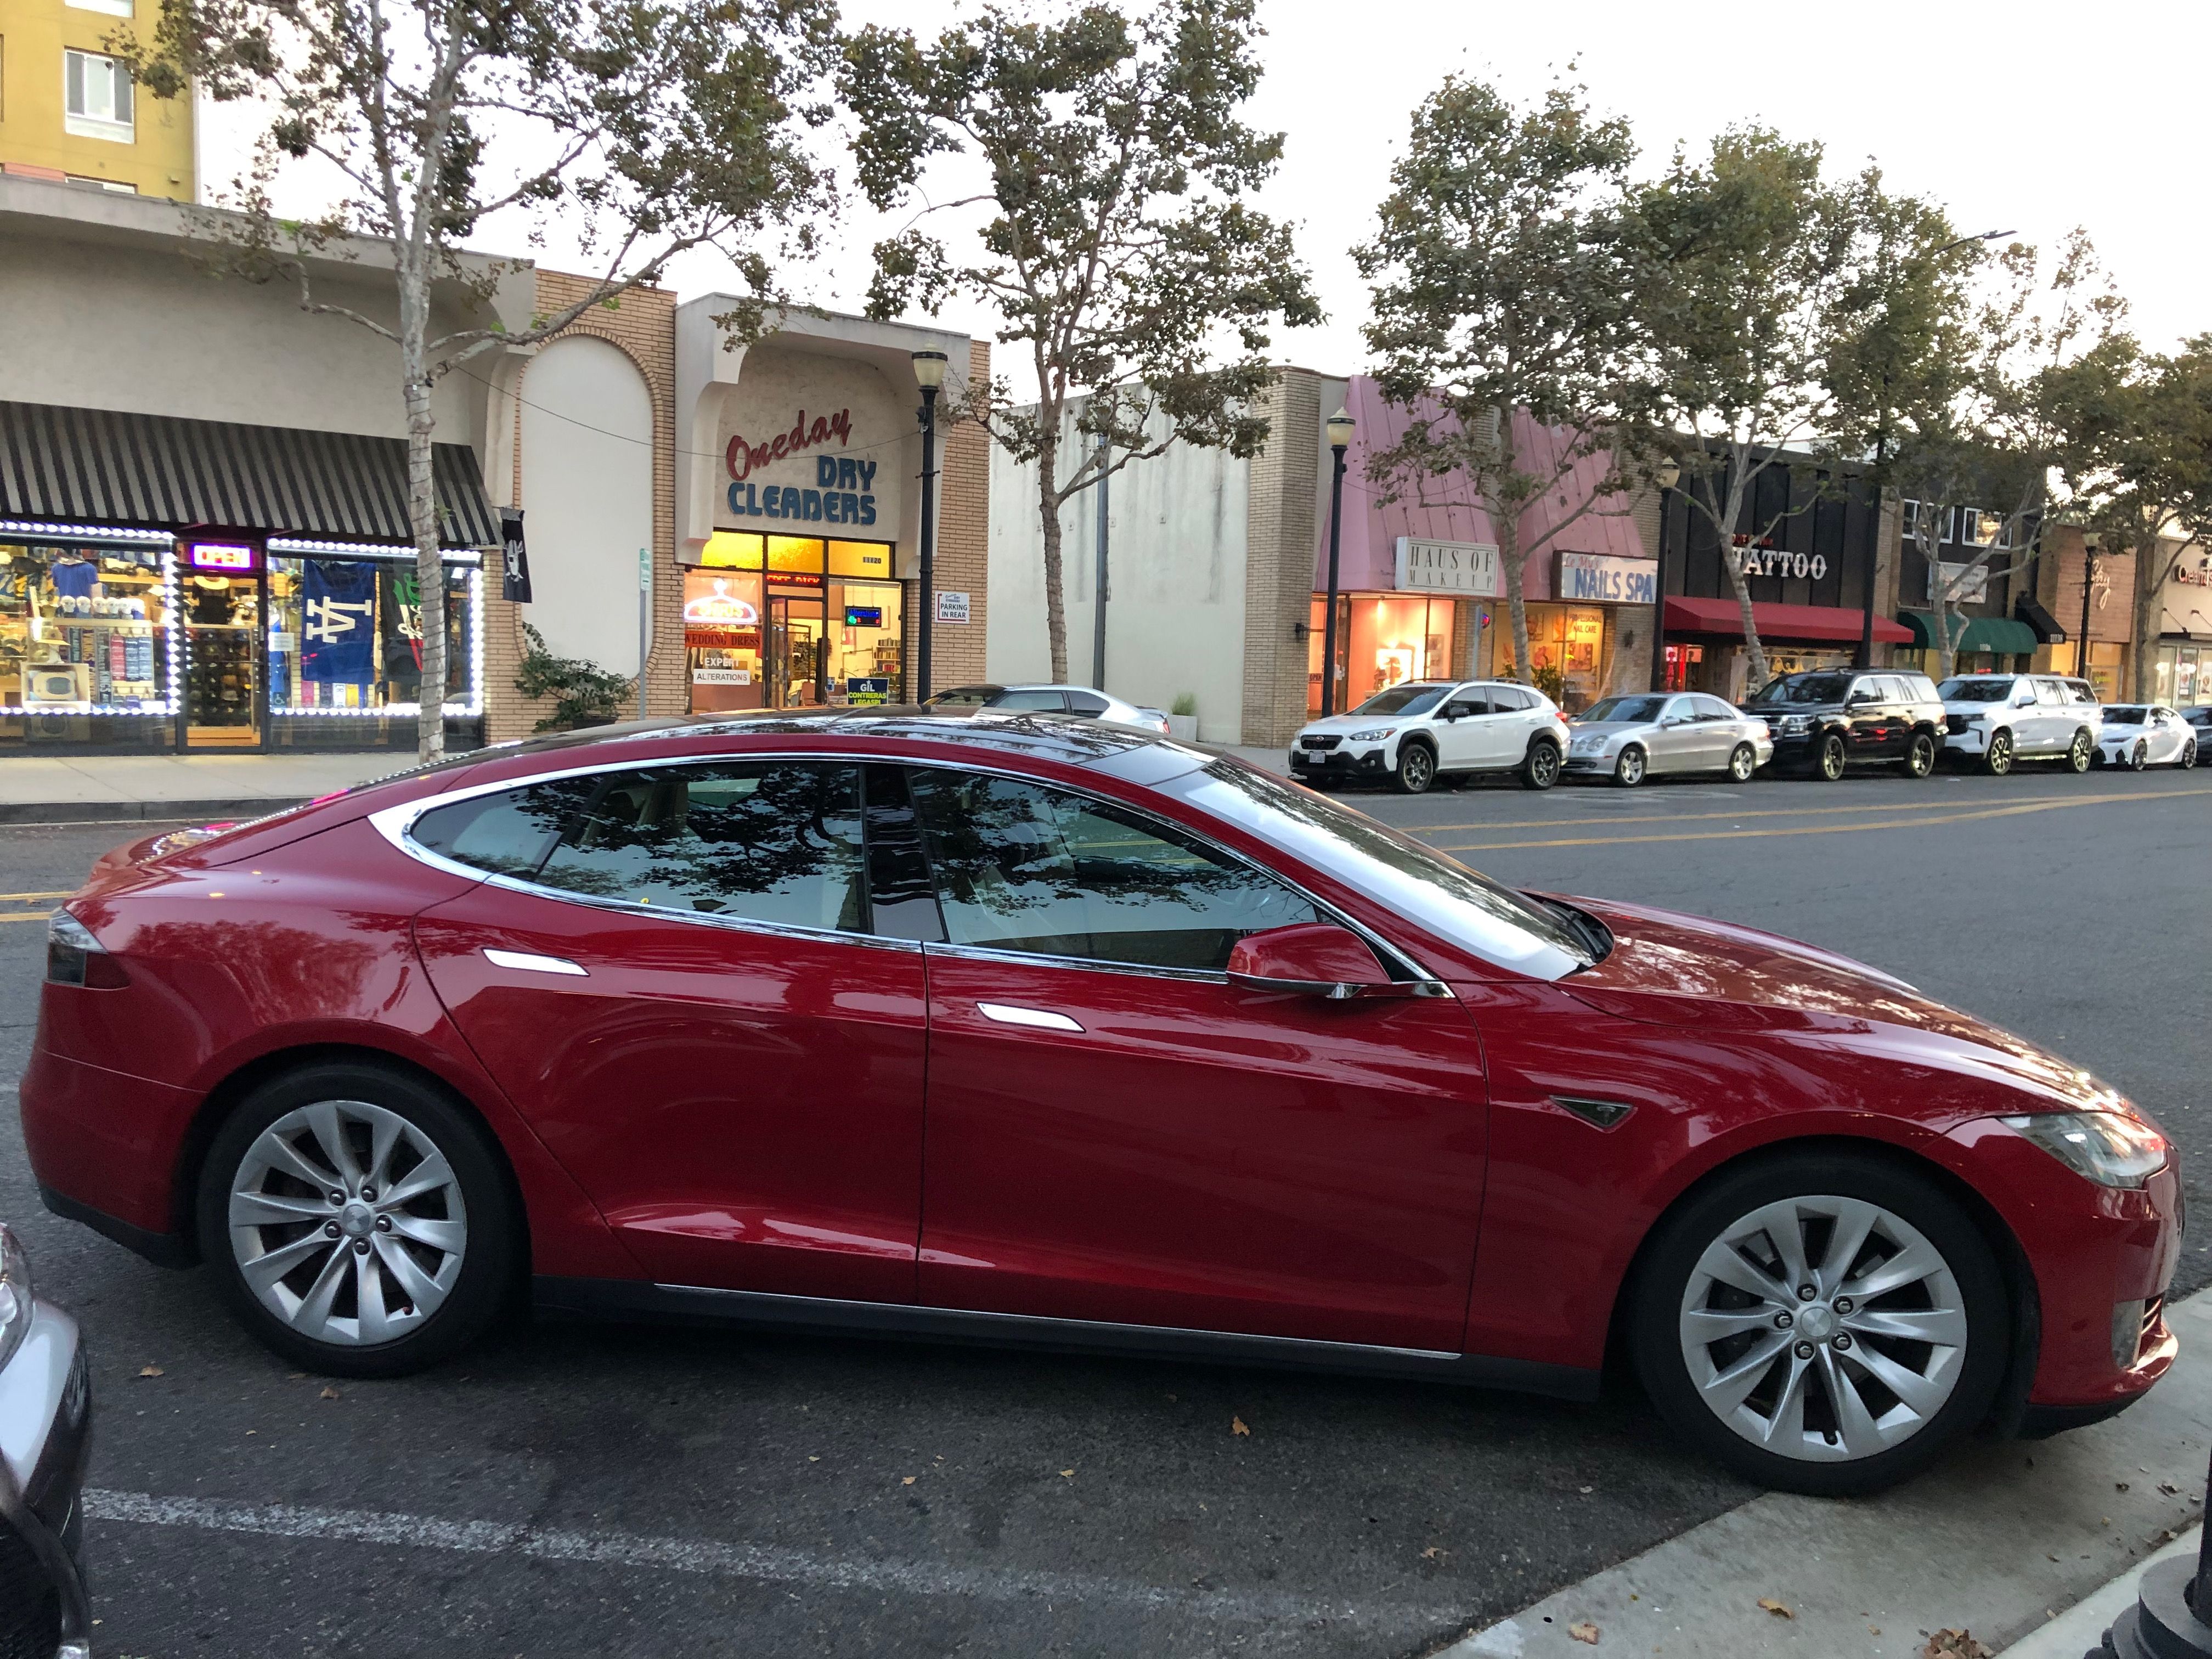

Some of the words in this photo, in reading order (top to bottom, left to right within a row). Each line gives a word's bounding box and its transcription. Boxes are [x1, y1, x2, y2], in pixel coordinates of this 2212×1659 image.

[726, 409, 853, 481] Oneday
[817, 455, 877, 492] DRY
[1410, 546, 1459, 569] HAUS
[1471, 551, 1493, 572] OF
[1731, 546, 1827, 580] TATTOO
[1575, 568, 1622, 600] NAILS
[1626, 572, 1654, 602] SPA
[685, 633, 727, 646] WEDDING
[731, 635, 760, 647] DRESS
[704, 657, 740, 667] EXPERT
[697, 673, 748, 681] ALTERATIONS
[860, 683, 875, 692] GIL
